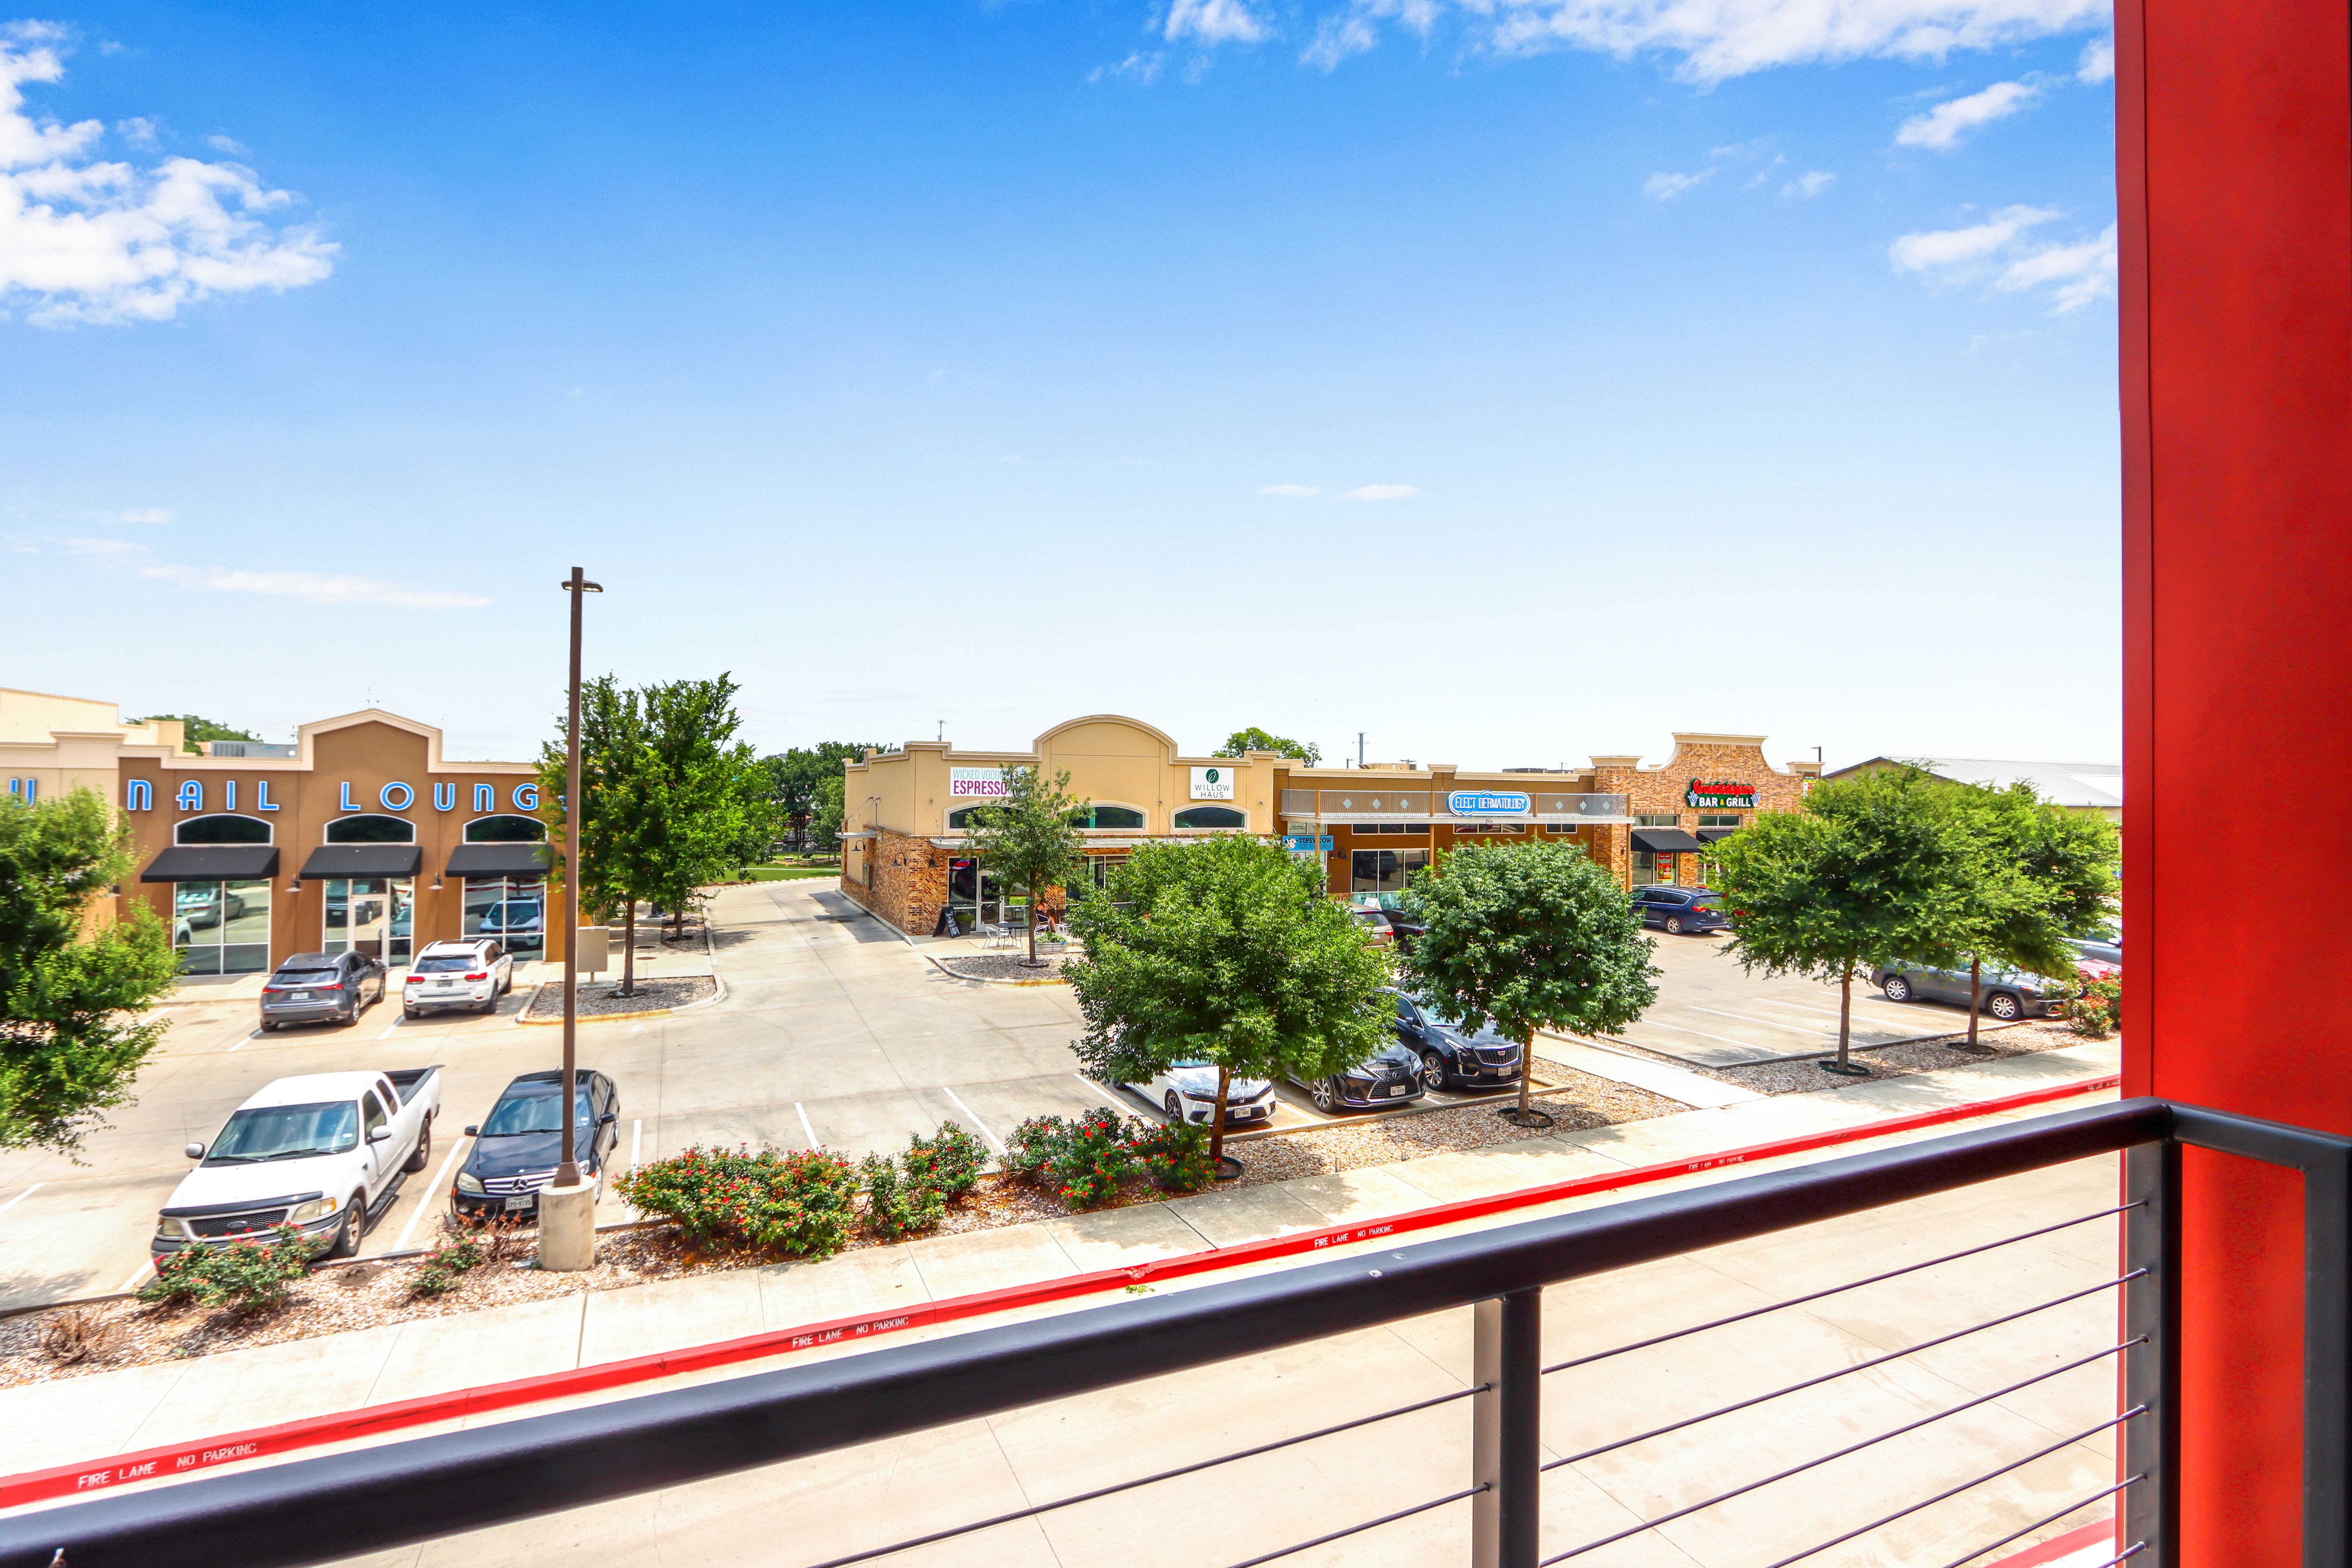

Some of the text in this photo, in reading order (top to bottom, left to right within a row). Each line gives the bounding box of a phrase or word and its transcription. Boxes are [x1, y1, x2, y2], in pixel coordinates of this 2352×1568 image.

[953, 769, 1006, 780] WICKED VOOD
[127, 779, 567, 811] NAIL LOUNG
[954, 780, 1007, 795] ESPRESSO
[1693, 779, 1754, 797] Guadalajara
[1455, 797, 1525, 809] ELECT DERMATOLOGY
[1699, 797, 1718, 807] BAR
[1726, 797, 1750, 807] GRILL
[1727, 1155, 1744, 1164] PARKING
[1315, 1237, 1328, 1247] FIRE
[1332, 1233, 1349, 1243] LANE
[1369, 1225, 1393, 1236] PARKING
[792, 1317, 909, 1348] FIRE LANE NO PARKING
[78, 1442, 257, 1489] FIRE LANE NO PARKING
